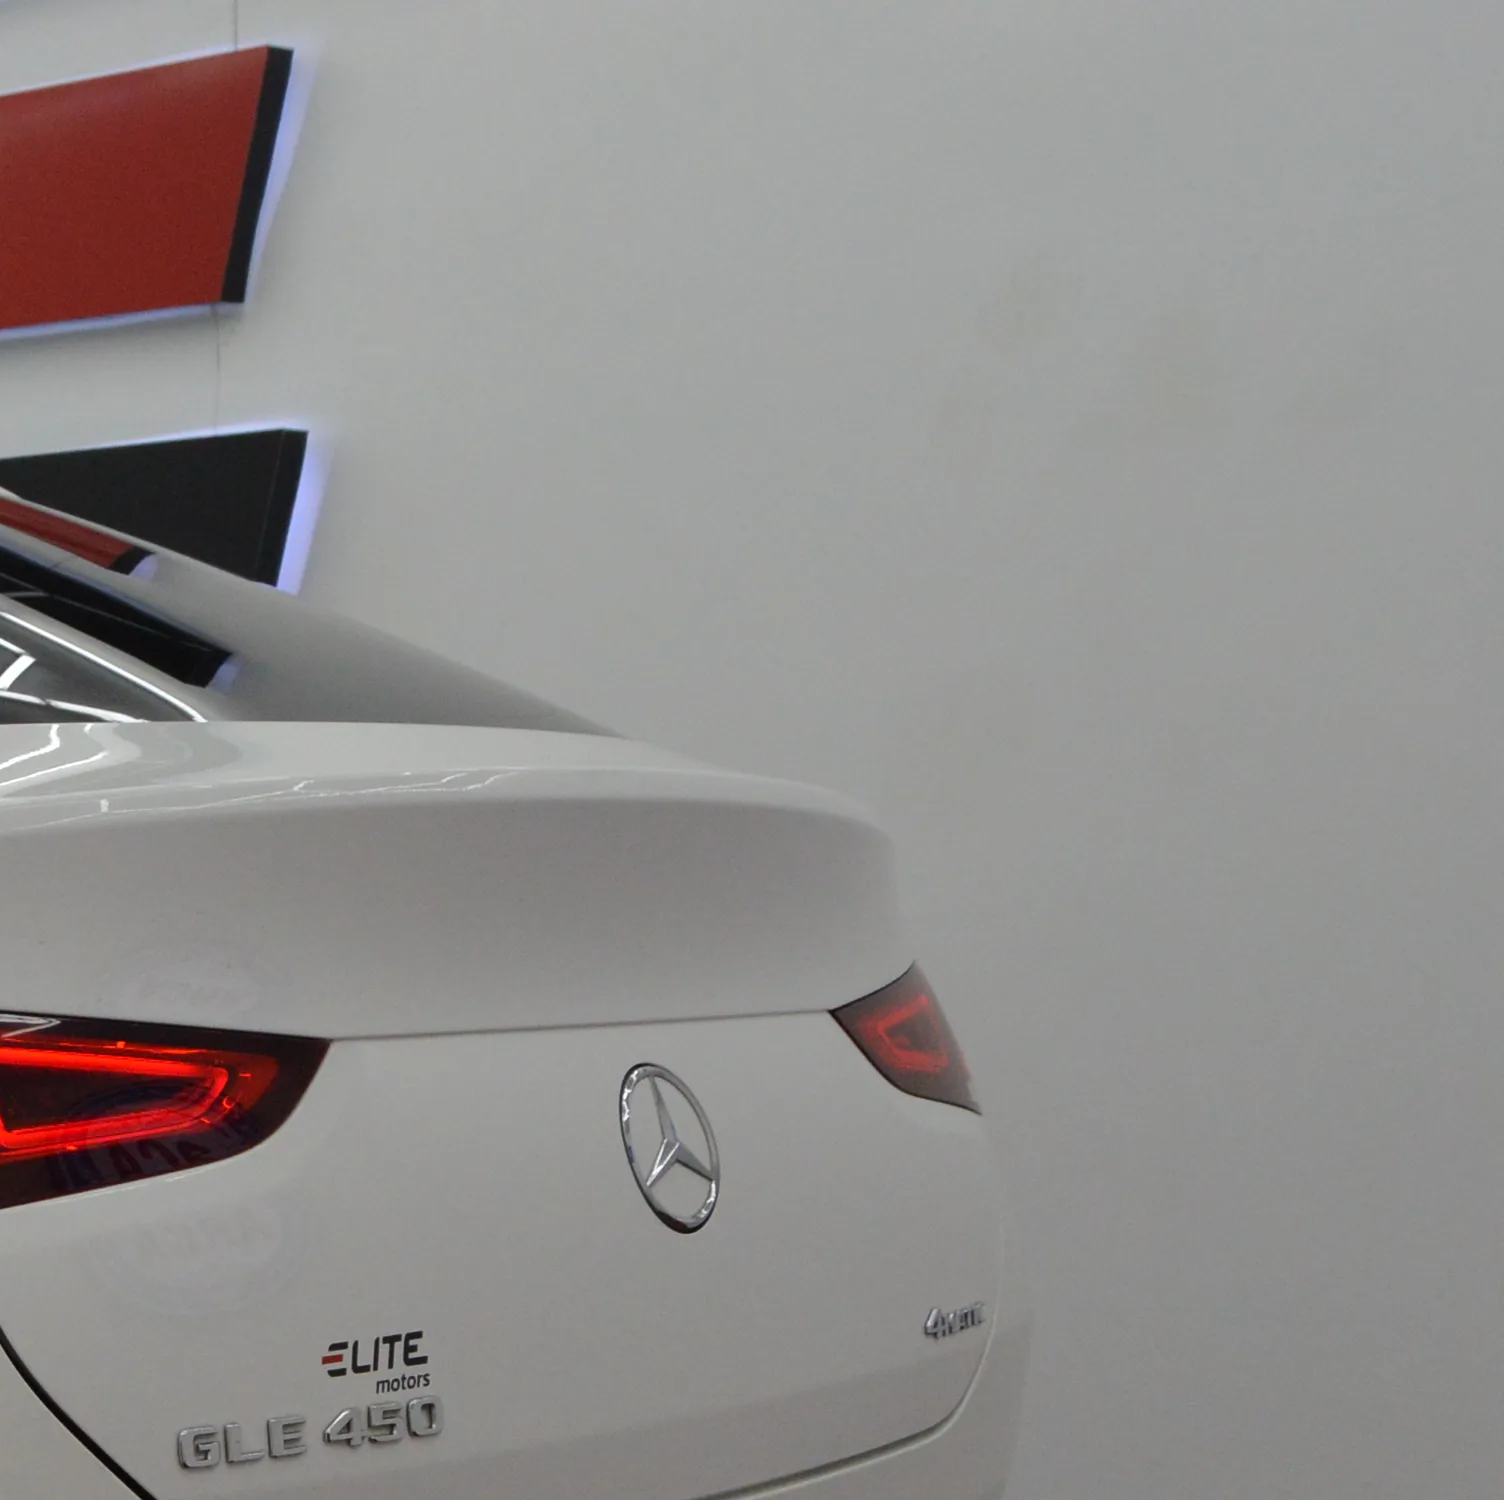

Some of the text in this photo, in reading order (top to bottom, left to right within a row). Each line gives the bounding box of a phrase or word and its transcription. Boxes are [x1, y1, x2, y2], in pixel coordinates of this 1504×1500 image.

[321, 1331, 429, 1378] ELITE
[375, 1372, 431, 1395] motors
[177, 1394, 445, 1469] GLE 450
